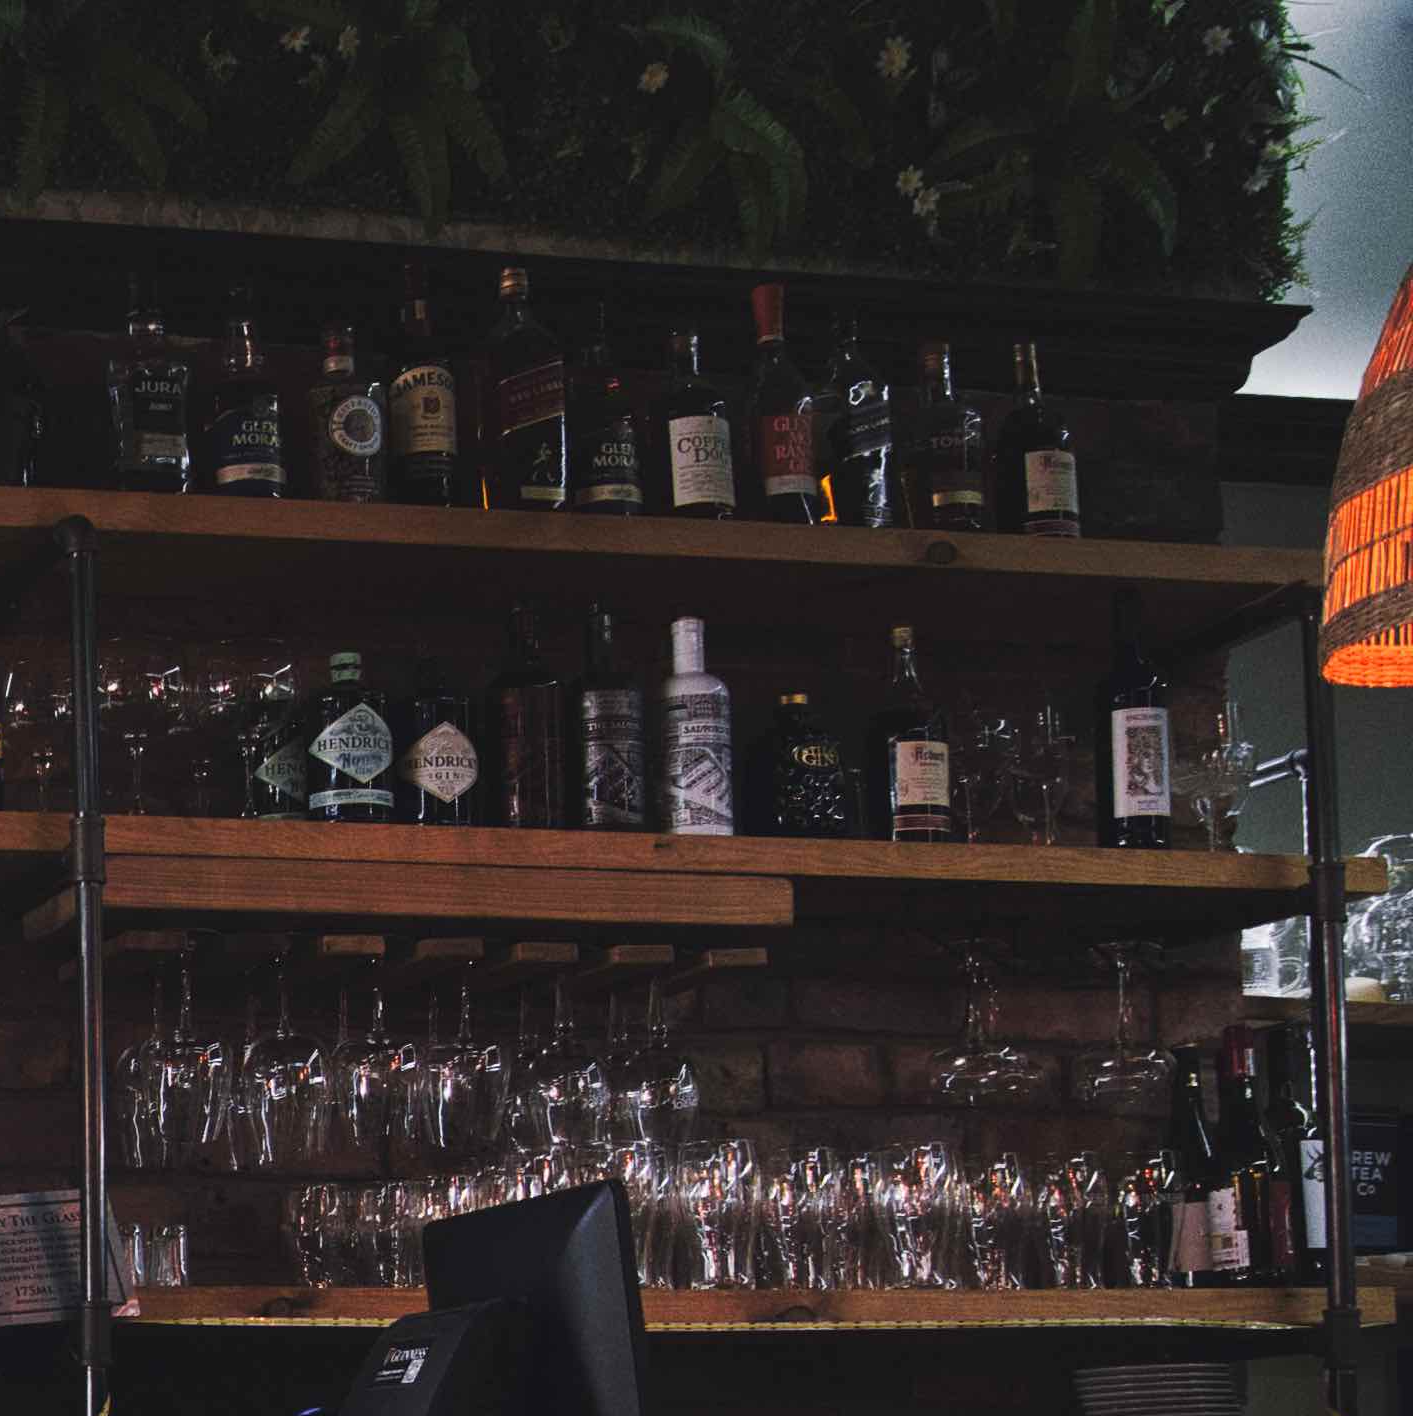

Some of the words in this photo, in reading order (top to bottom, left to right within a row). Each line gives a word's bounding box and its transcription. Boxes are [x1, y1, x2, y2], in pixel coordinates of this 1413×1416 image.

[135, 380, 182, 394] JURA
[232, 434, 279, 447] MORA
[594, 454, 636, 467] MORA
[317, 735, 389, 753] HENDRIC
[407, 757, 477, 769] ENDRIC
[1350, 1150, 1393, 1167] REW
[1351, 1166, 1383, 1181] TEA
[1356, 1183, 1376, 1197] Co
[9, 1214, 37, 1227] THE
